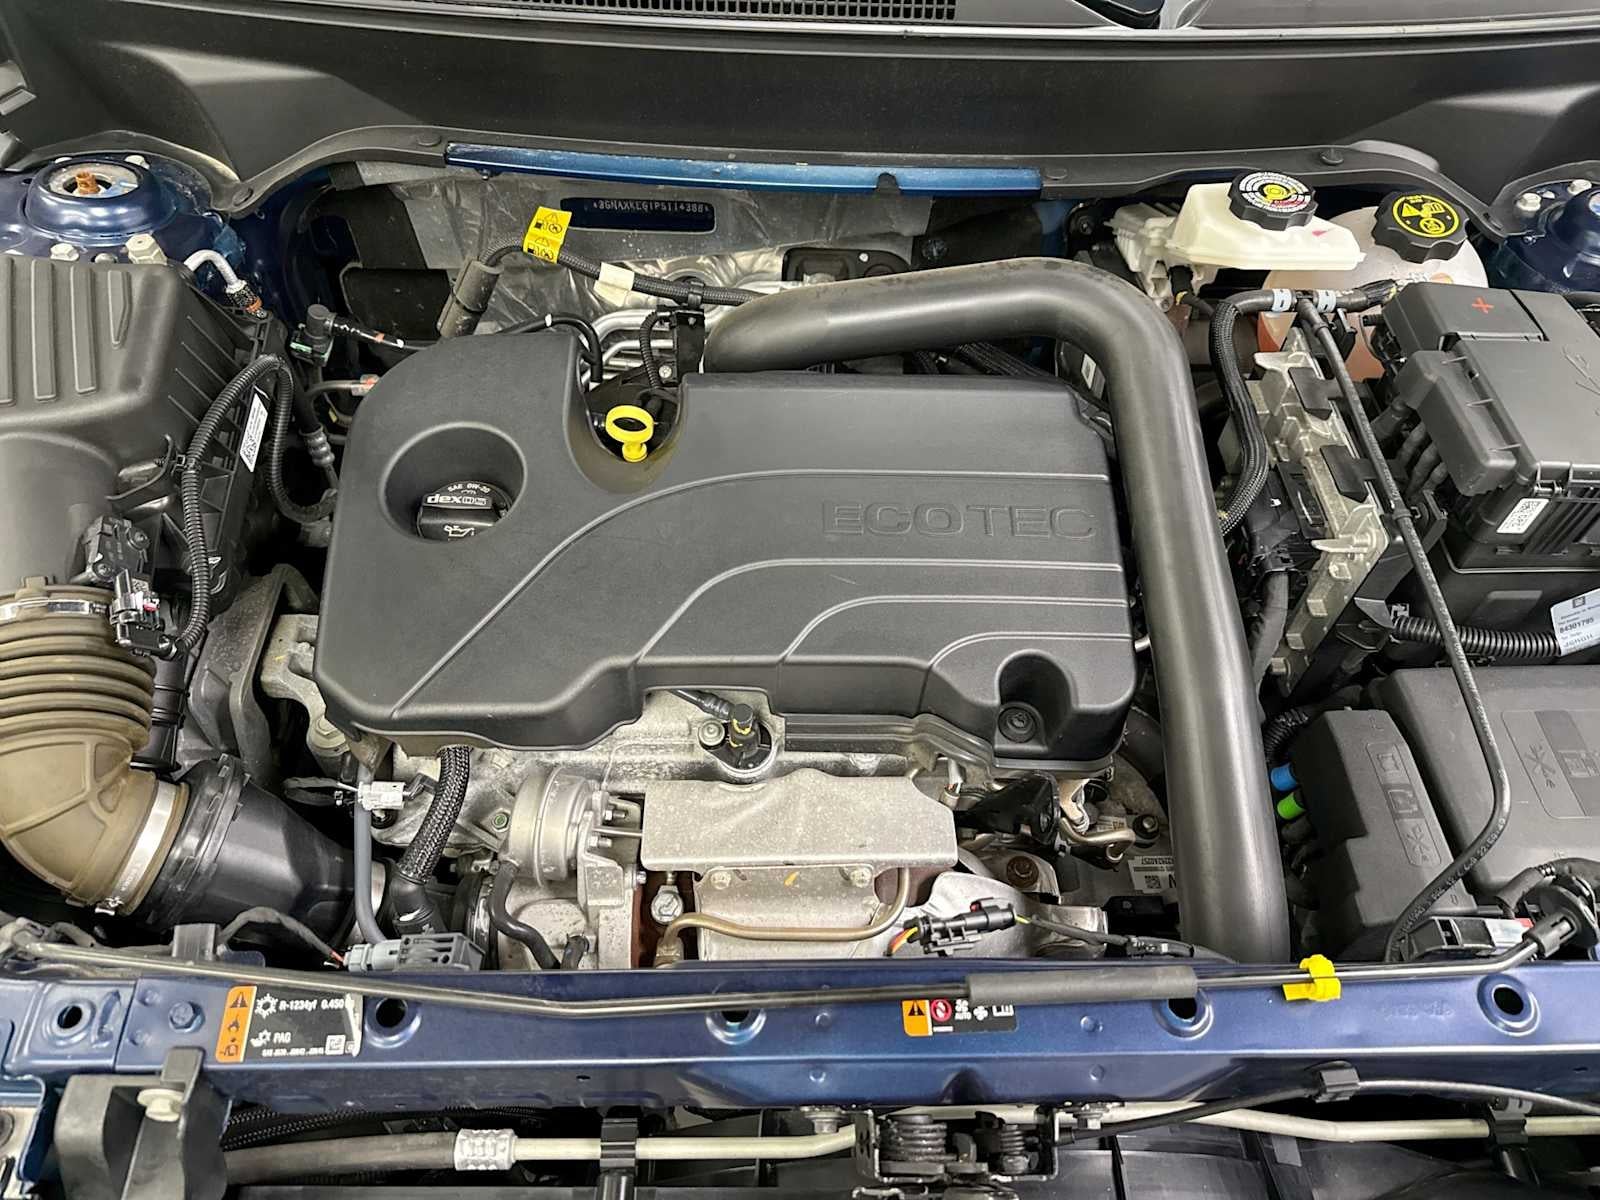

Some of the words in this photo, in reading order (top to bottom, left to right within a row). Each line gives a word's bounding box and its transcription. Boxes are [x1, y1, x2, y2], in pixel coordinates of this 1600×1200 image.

[822, 502, 1097, 539] ECOTEC
[278, 999, 318, 1012] R-1234yf
[273, 1032, 292, 1044] PAG
